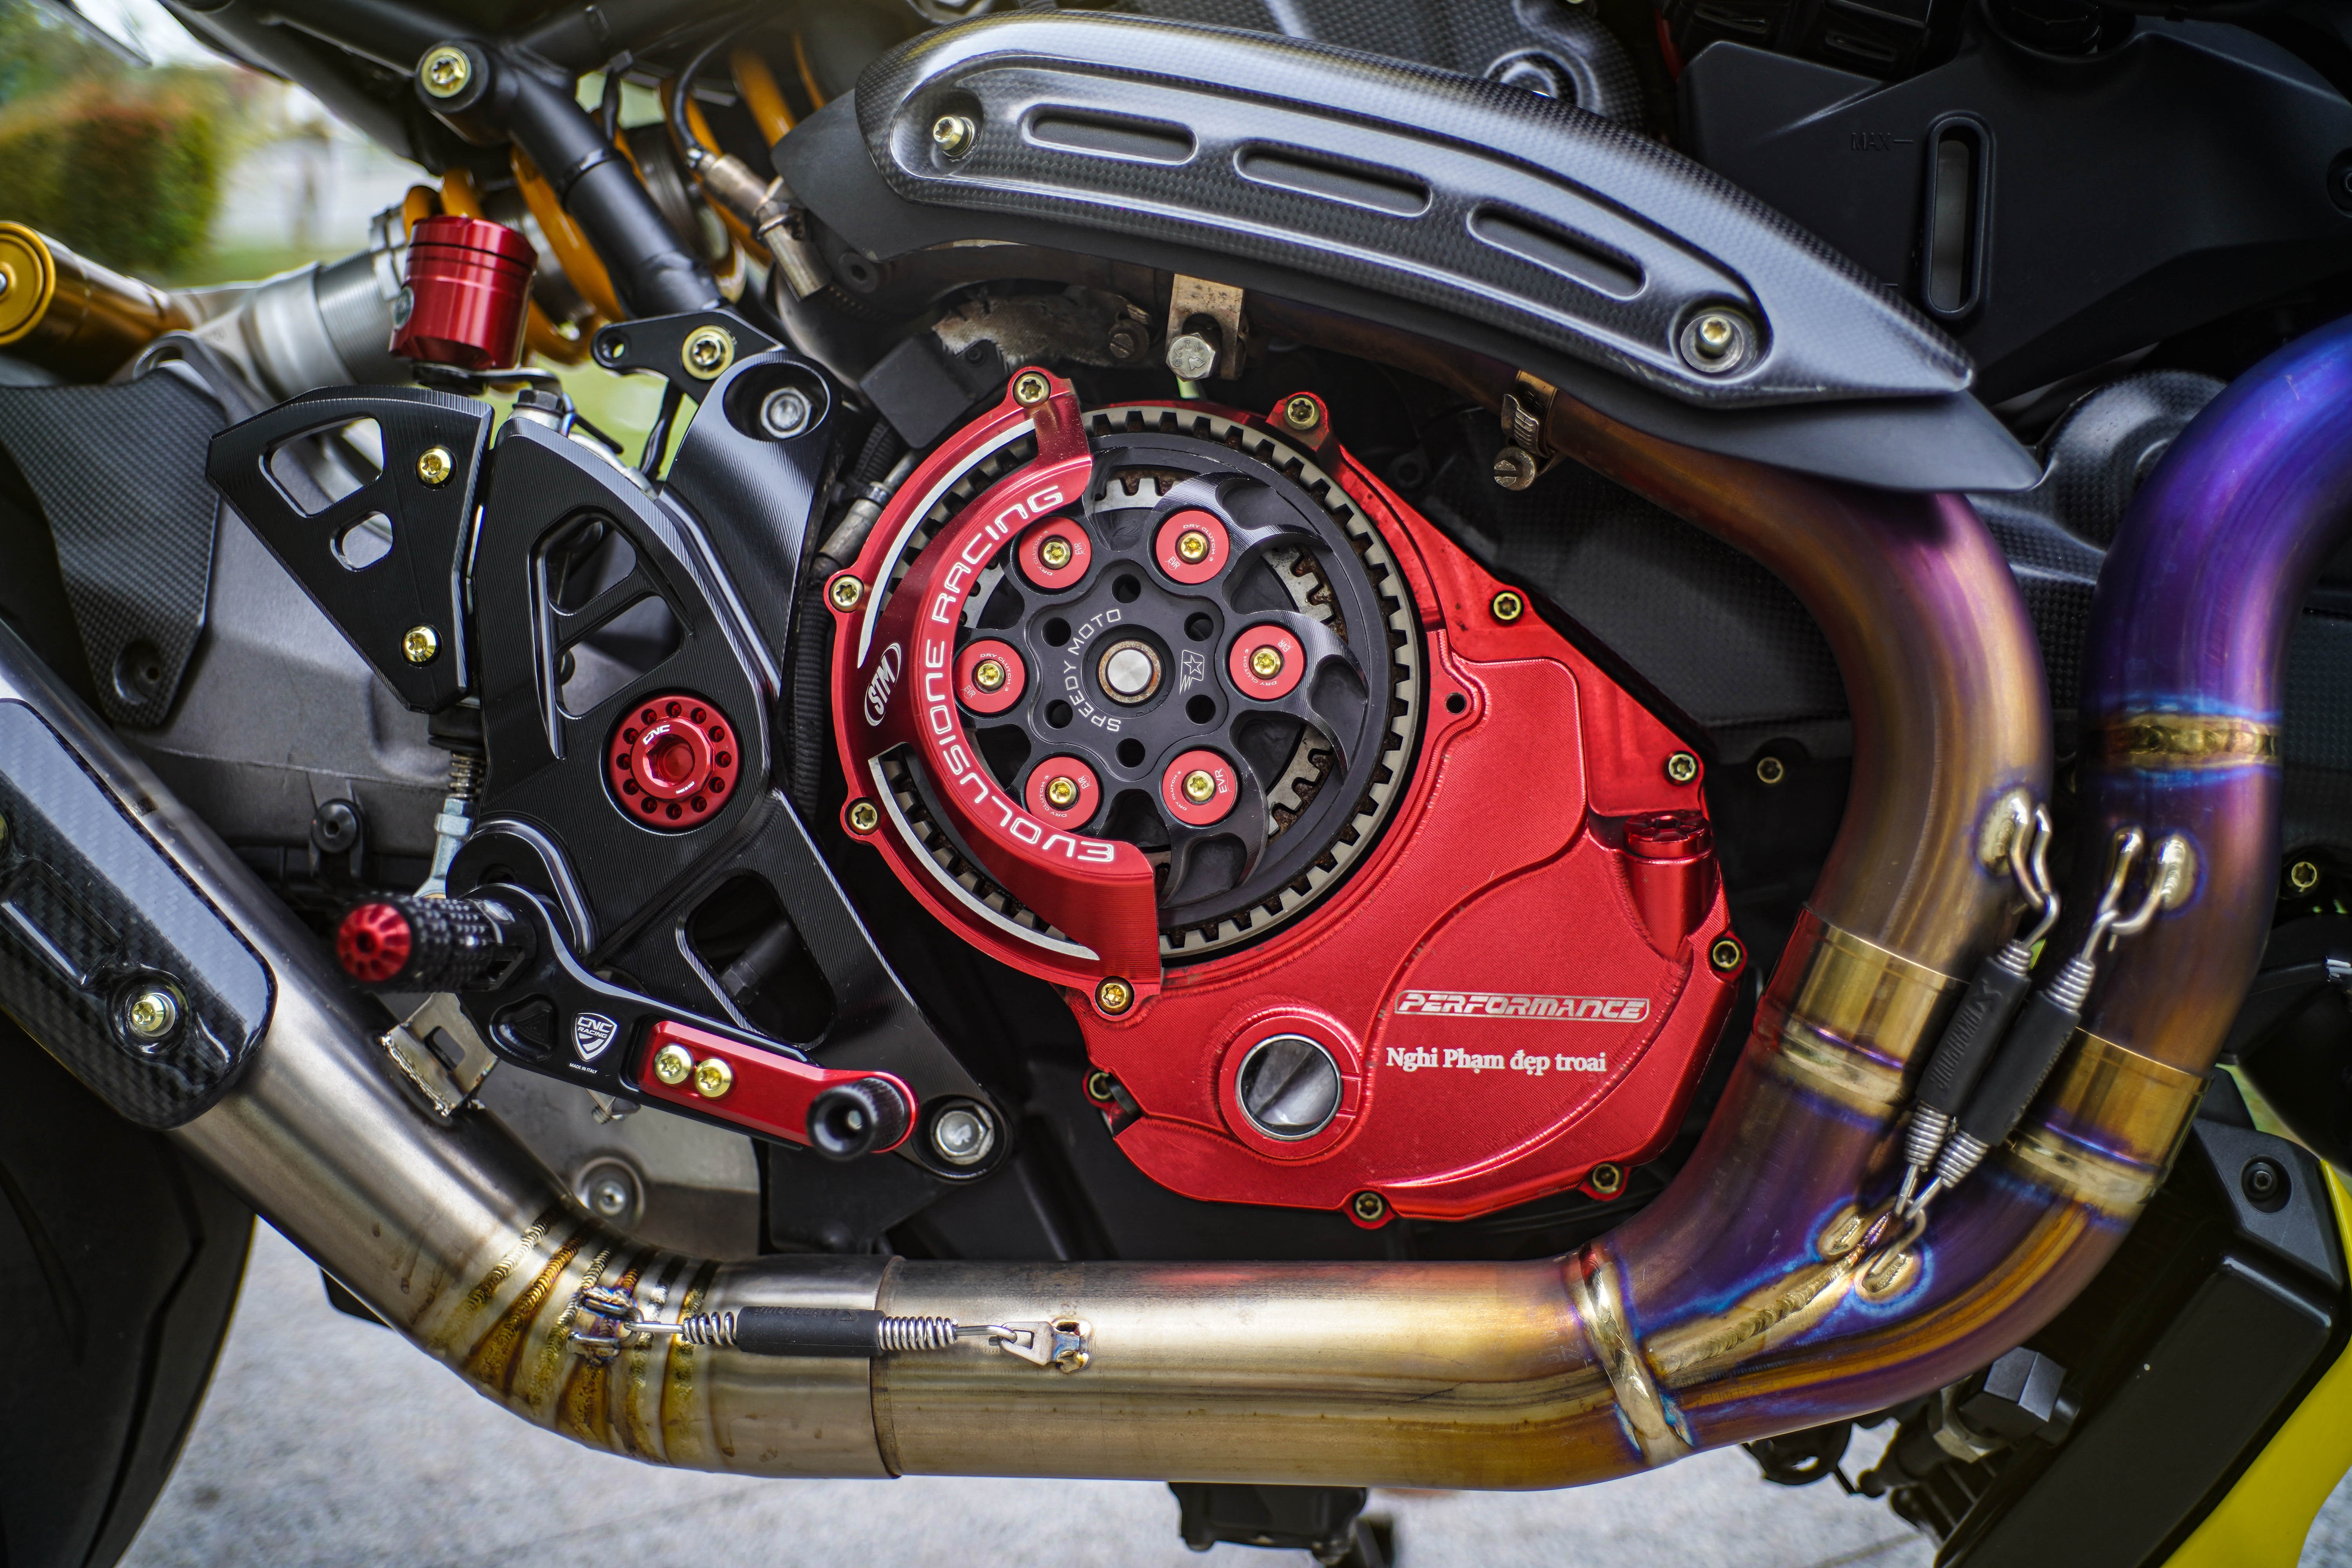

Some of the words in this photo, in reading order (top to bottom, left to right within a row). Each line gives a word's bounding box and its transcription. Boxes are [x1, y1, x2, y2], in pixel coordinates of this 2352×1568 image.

[1851, 133, 1891, 151] MAX
[1032, 535, 1042, 564] CLUTCH
[1074, 542, 1083, 555] EVR
[1201, 527, 1215, 555] CLUTCH
[931, 485, 1063, 624] RACING
[1168, 556, 1180, 570] EVR
[1037, 566, 1053, 576] DRY
[1067, 608, 1122, 655] MOTO
[1278, 639, 1291, 653] EVR
[998, 656, 1011, 684] CLUTCH
[1243, 656, 1258, 683] CLUTCH
[868, 655, 895, 715] STM
[964, 685, 976, 698] EVR
[1063, 660, 1121, 732] SPEEDY
[642, 724, 670, 745] CNC
[925, 639, 1114, 862] EVOLUSIONE
[1078, 775, 1089, 789] EVR
[1215, 768, 1227, 793] EVR
[1039, 782, 1049, 811] CLUTCH
[1175, 802, 1187, 811] DRY
[1399, 993, 1646, 1019] PERFORMANCE
[577, 1016, 613, 1033] CNC
[578, 1027, 608, 1038] RACING
[1386, 1047, 1438, 1072] Nghi
[1442, 1048, 1505, 1074] Phạm
[1510, 1049, 1550, 1076] đẹp
[1555, 1052, 1606, 1072] troai
